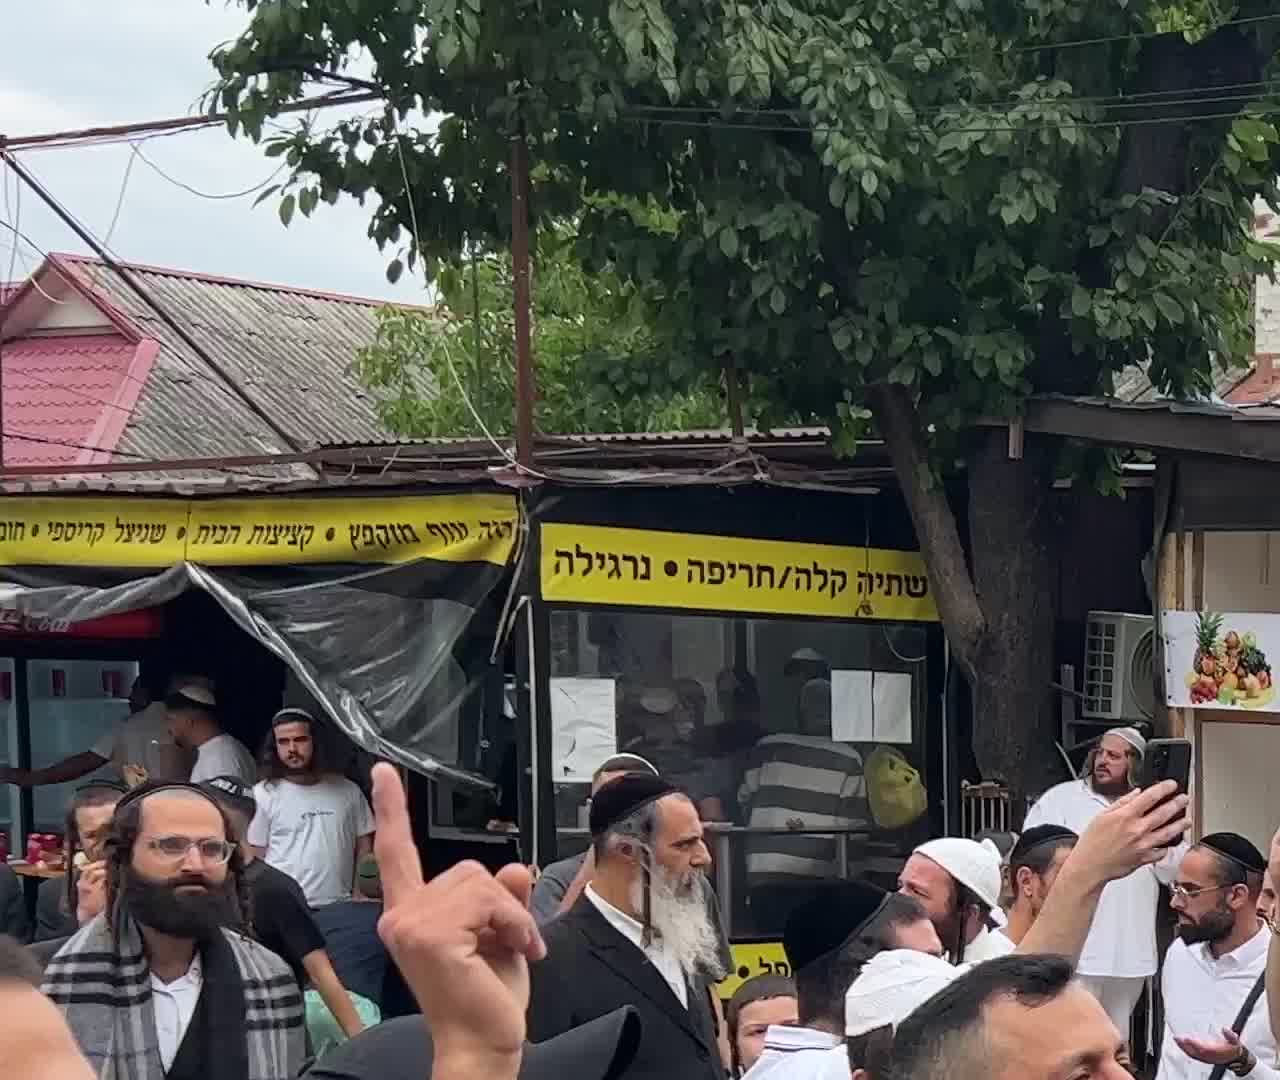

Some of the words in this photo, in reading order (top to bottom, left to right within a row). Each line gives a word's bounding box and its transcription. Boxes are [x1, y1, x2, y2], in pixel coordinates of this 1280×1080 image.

[47, 521, 105, 547] קריספי
[114, 516, 167, 544] שניצל
[554, 543, 651, 580] נרגילה
